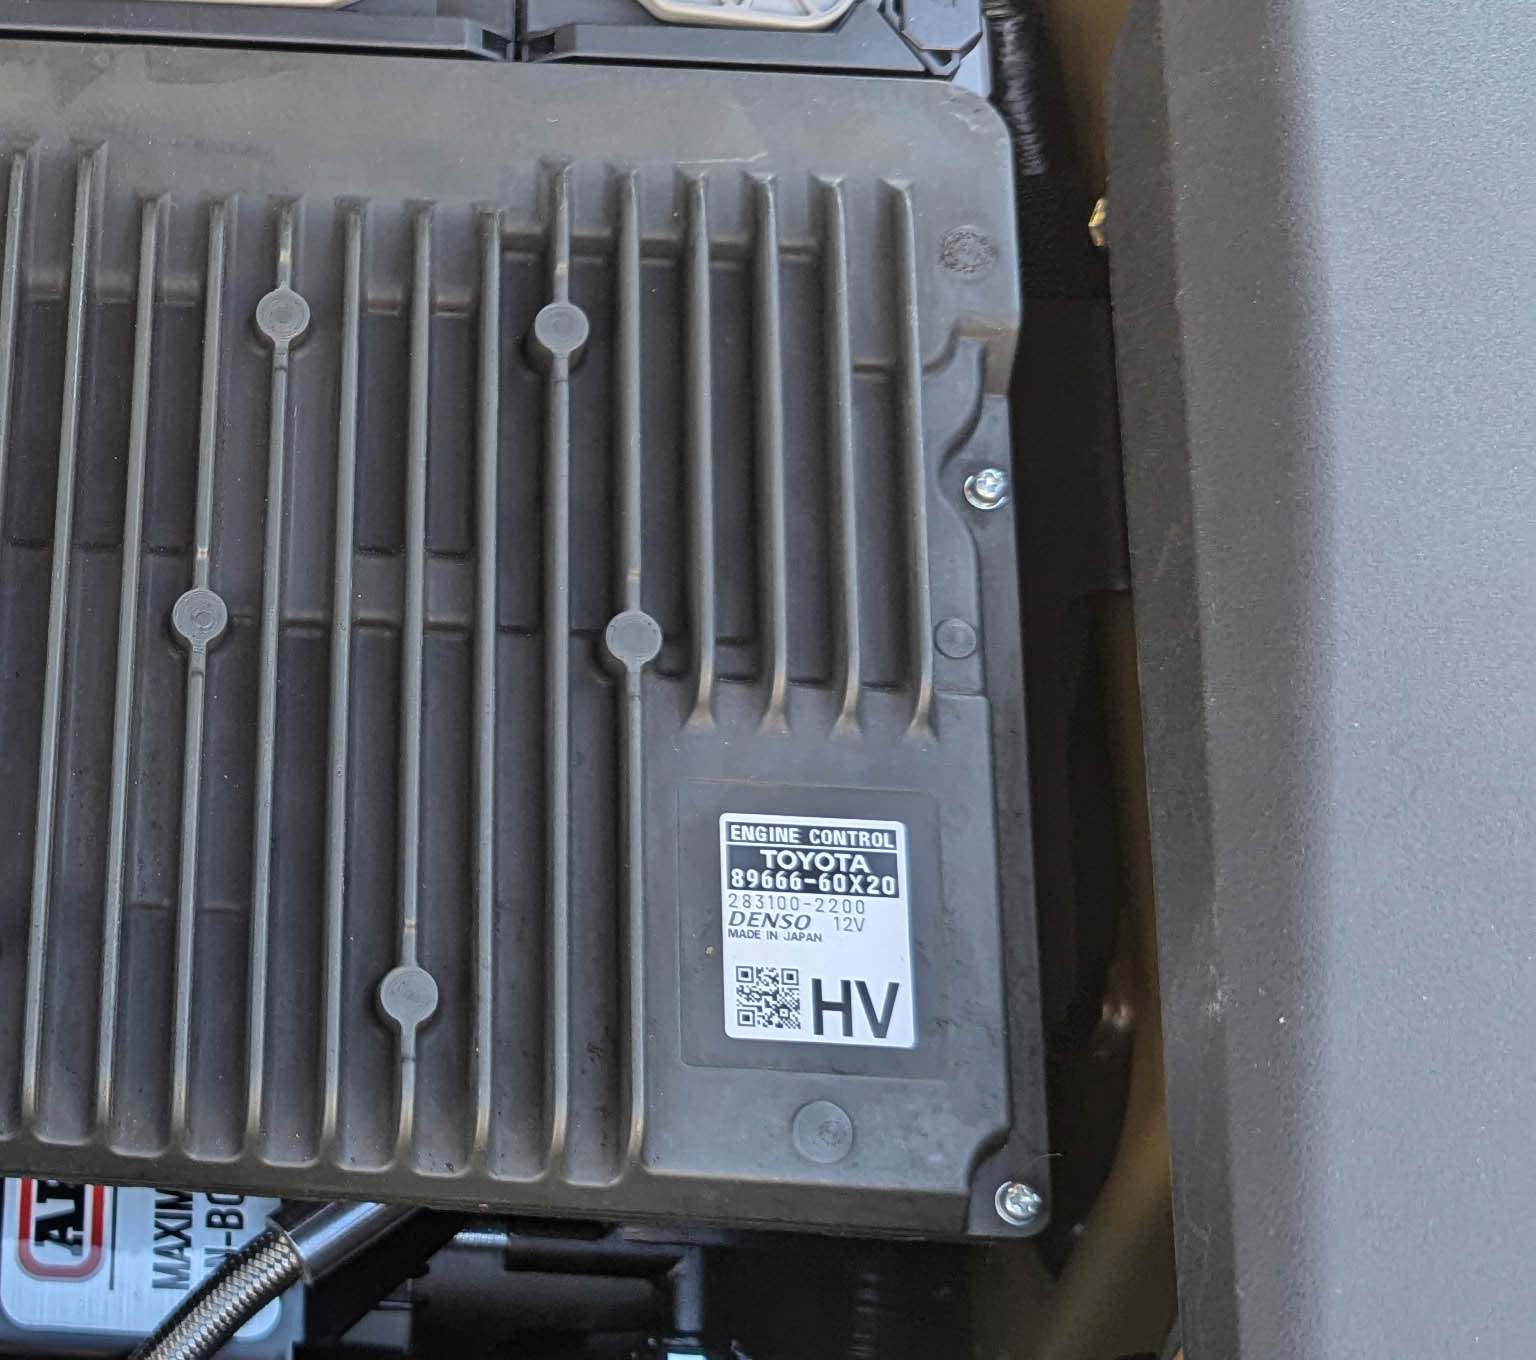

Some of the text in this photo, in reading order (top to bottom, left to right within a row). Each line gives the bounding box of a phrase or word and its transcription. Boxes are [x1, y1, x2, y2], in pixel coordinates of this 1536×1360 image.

[730, 824, 895, 849] ENGINE CONTROL
[760, 848, 871, 874] TOYOTA
[730, 868, 897, 896] 89666-60X20
[727, 893, 866, 915] 283100-2200
[727, 910, 866, 933] DENSO 12V
[727, 928, 823, 943] MADE IN JAPAN
[811, 977, 900, 1039] HV
